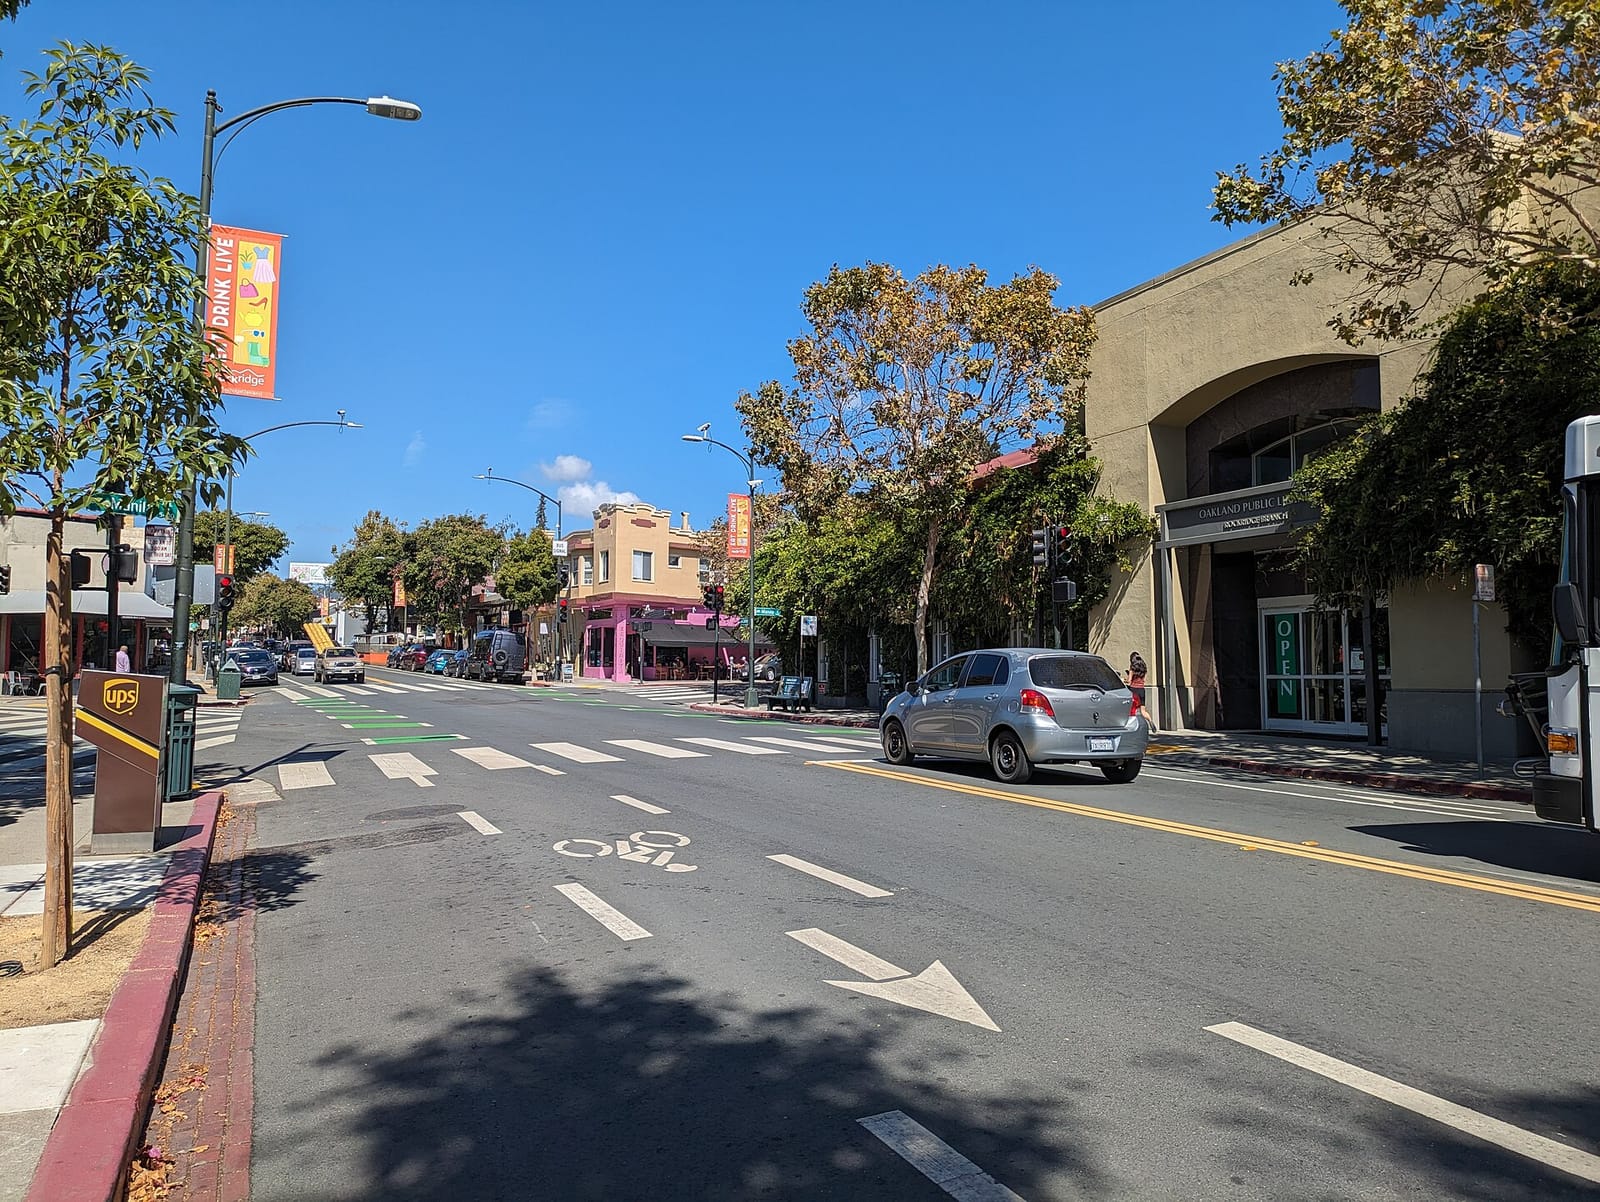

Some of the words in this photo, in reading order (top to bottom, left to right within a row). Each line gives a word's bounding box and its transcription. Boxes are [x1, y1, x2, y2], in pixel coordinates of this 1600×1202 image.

[215, 237, 234, 273] LIVE
[211, 277, 232, 327] DRINK
[1199, 503, 1241, 519] OAKLAND
[1242, 497, 1276, 512] PUBLIC
[1277, 620, 1293, 697] OPEN
[106, 689, 137, 709] ups
